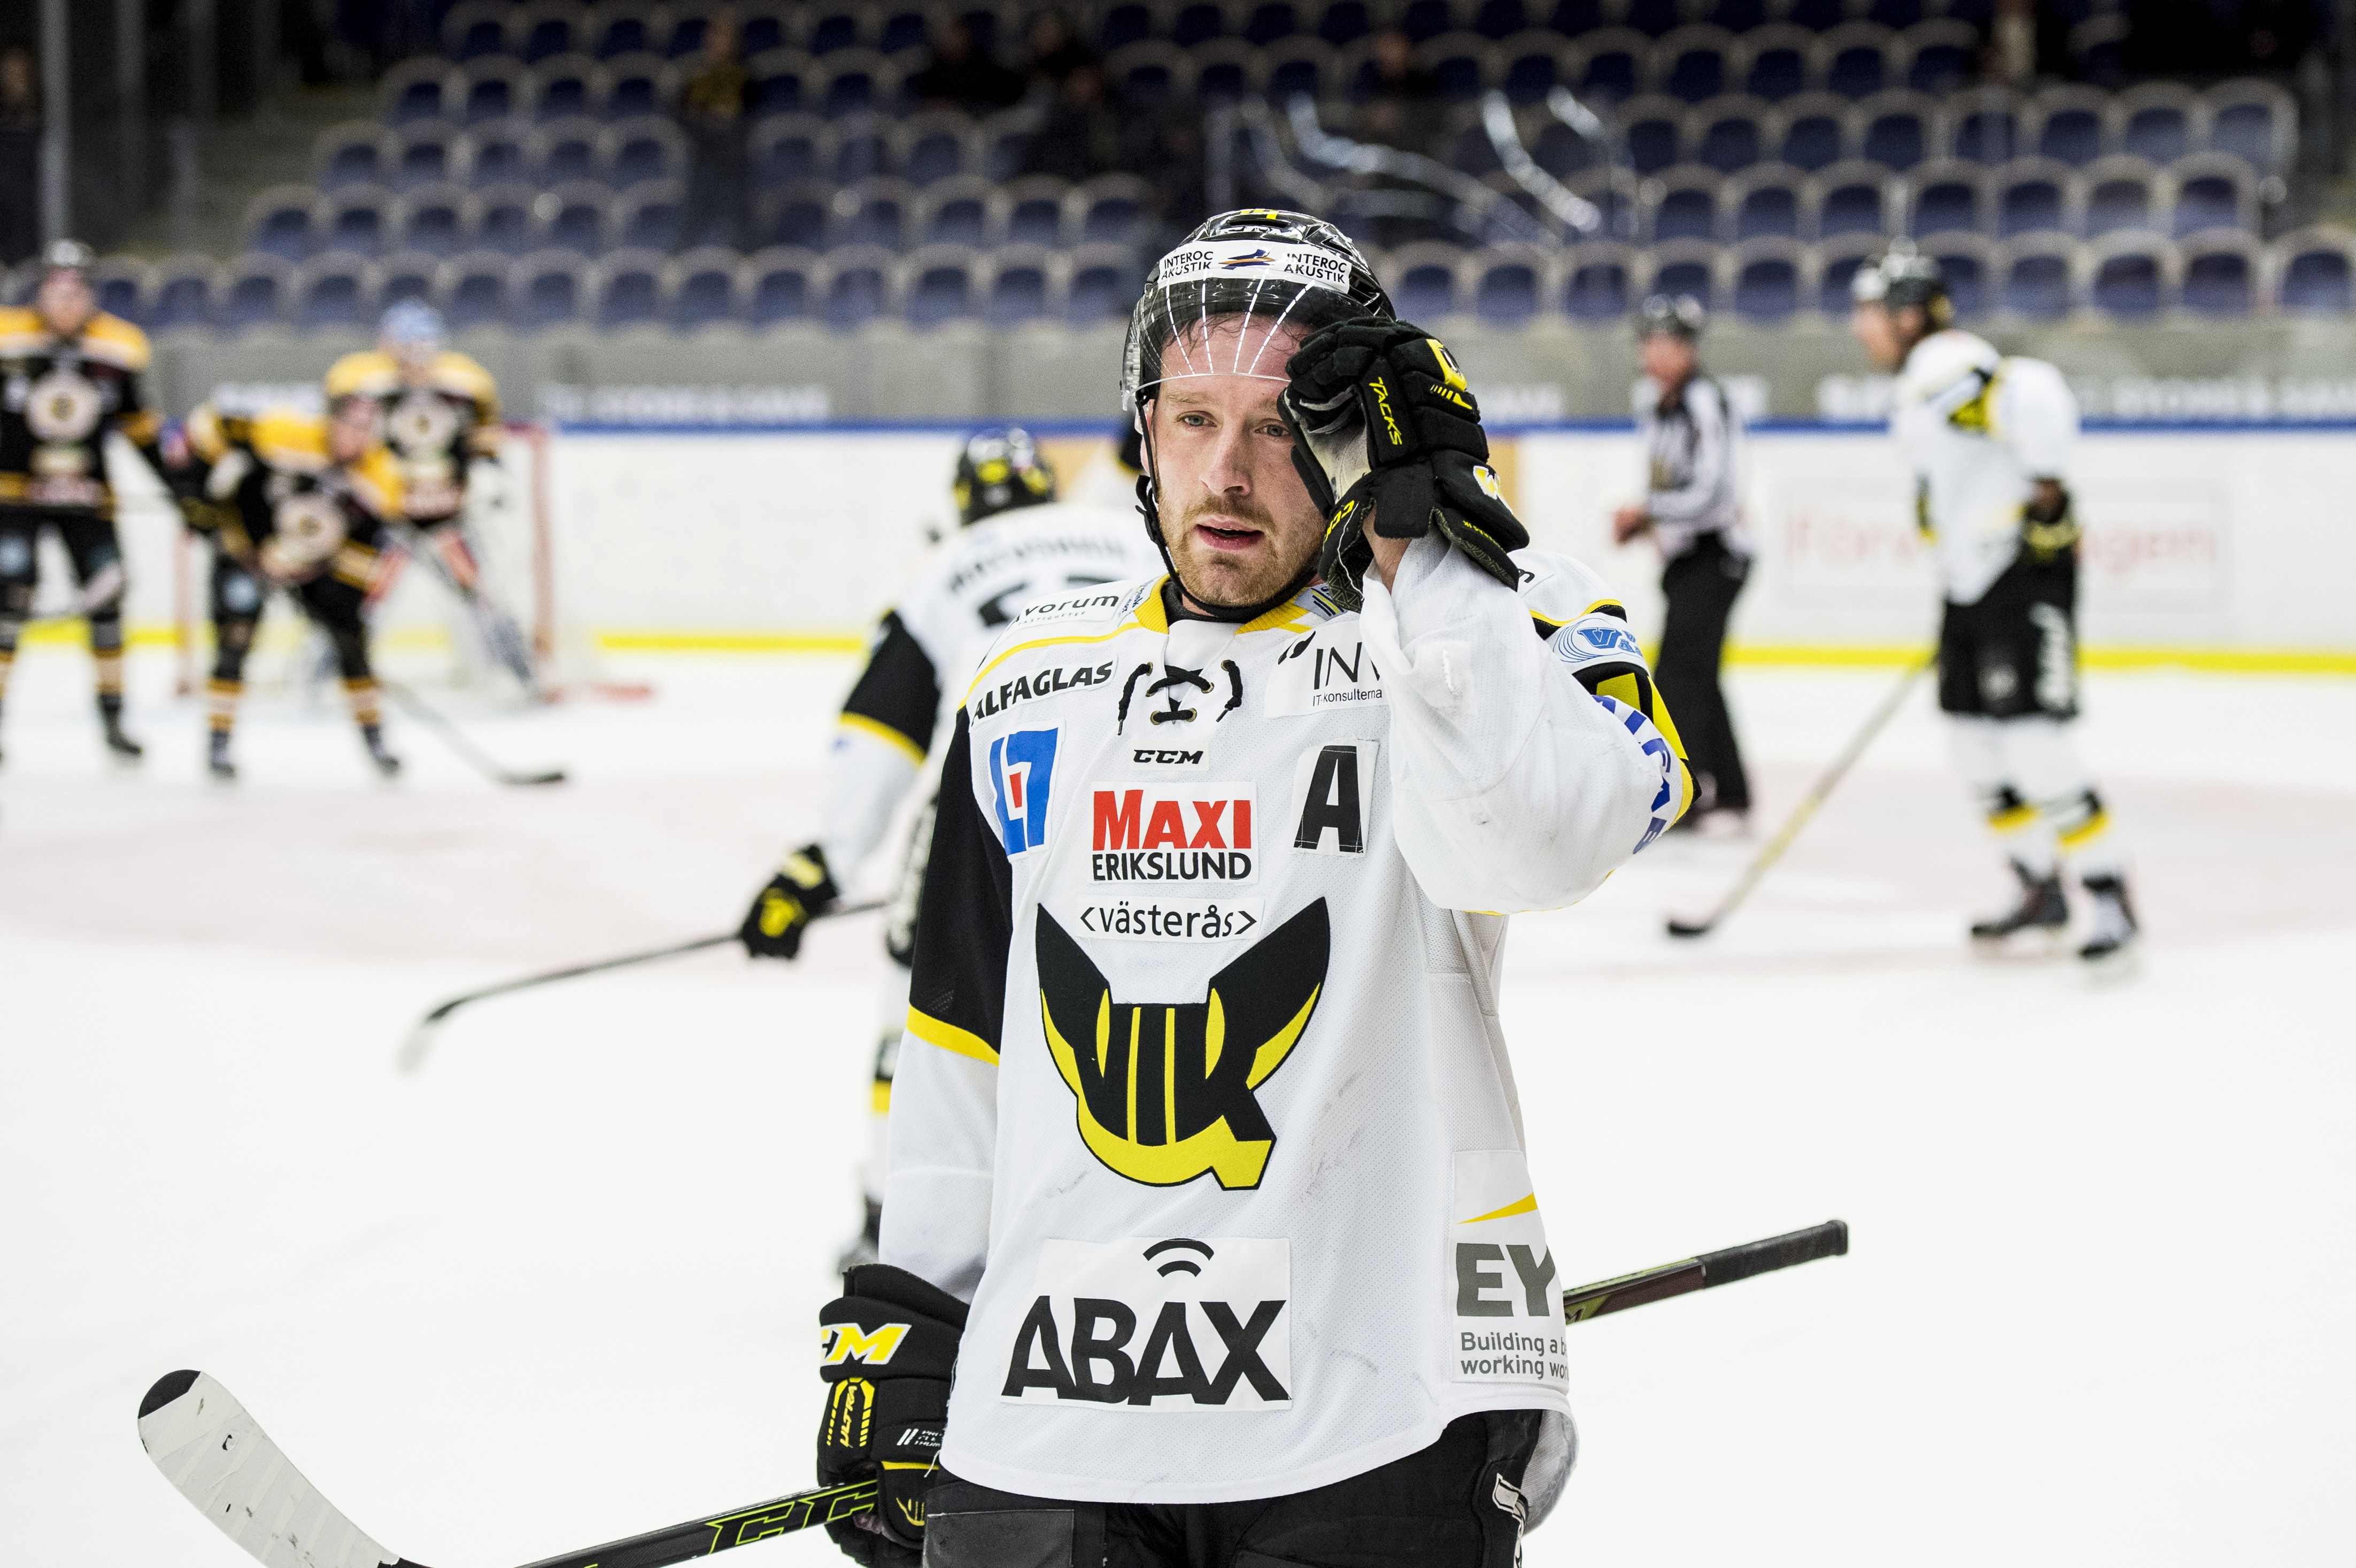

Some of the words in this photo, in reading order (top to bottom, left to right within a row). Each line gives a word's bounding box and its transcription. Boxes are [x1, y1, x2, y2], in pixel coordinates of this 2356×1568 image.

[1161, 261, 1212, 280] AKUSTIK
[1164, 251, 1214, 269] INTEROC
[1286, 253, 1347, 273] INTEROC
[1284, 264, 1345, 284] AKUSTIK
[1369, 376, 1403, 445] TACKS
[1016, 596, 1119, 623] vorum
[1314, 642, 1380, 690] IN
[971, 660, 1114, 724] ALFAGLAS
[1313, 688, 1382, 706] IT-konsulterna
[1133, 750, 1204, 764] CCM
[1294, 745, 1364, 853] A
[1093, 790, 1252, 851] MAXI
[1093, 852, 1252, 881] ERIKSLUND
[1456, 1242, 1556, 1317] EY
[1001, 1295, 1293, 1406] ABAX
[1461, 1332, 1544, 1357] Building
[1550, 1339, 1558, 1354] a
[1461, 1354, 1544, 1380] working
